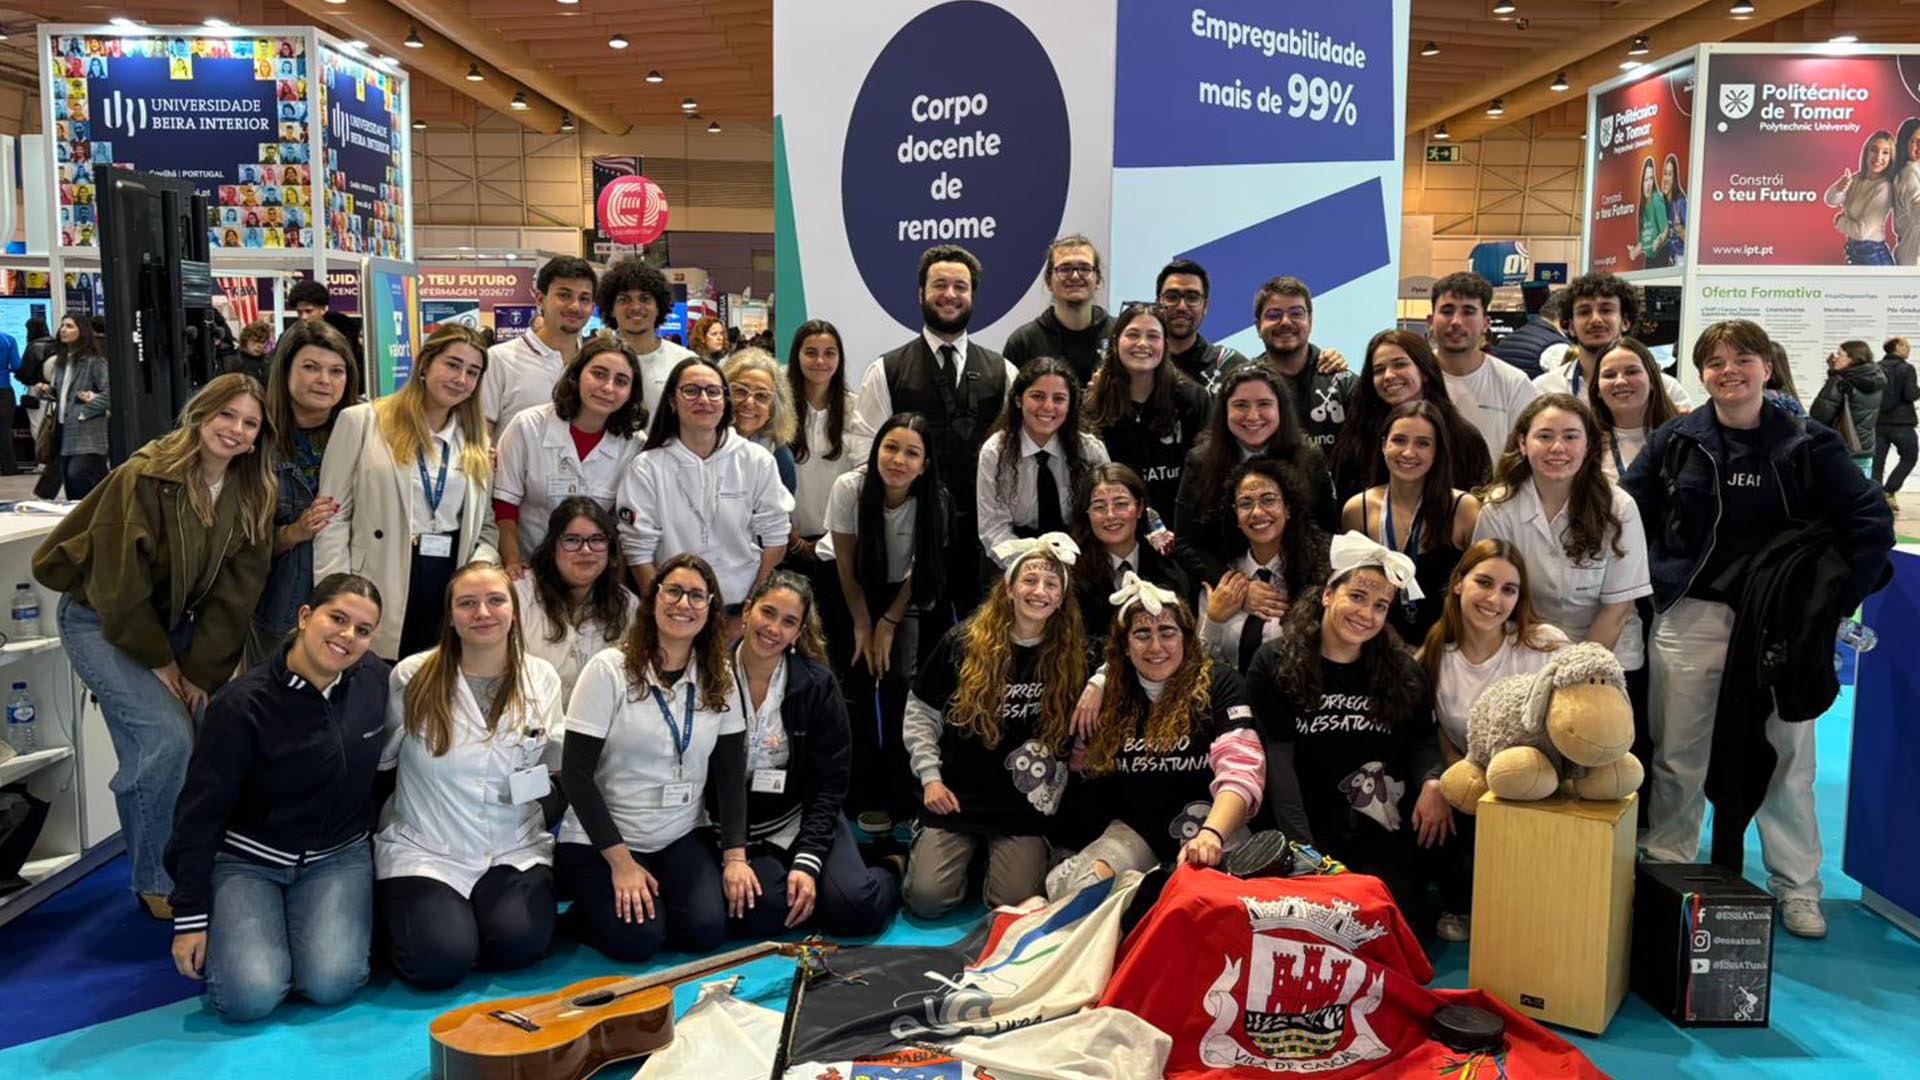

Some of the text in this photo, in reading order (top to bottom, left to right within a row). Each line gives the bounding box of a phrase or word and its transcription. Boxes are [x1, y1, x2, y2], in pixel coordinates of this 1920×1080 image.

[1191, 8, 1366, 69] Empregabilidade
[1199, 72, 1358, 126] mais de 99%
[1762, 83, 1869, 101] Politécnico
[151, 98, 261, 113] UNIVERSIDADE
[911, 93, 988, 125] Corpo
[1760, 102, 1854, 119] de Tomar
[152, 116, 270, 131] BEIRA INTERIOR
[1759, 121, 1861, 133] Polytechnic University
[1614, 123, 1652, 145] de Tomar
[897, 130, 1002, 164] docente
[182, 170, 225, 178] PORTUGAL
[1730, 173, 1784, 186] Constrói
[930, 171, 963, 200] de
[1712, 187, 1817, 201] o teu Futuro
[898, 216, 997, 241] renome
[1712, 244, 1774, 256] www.ipt.pt
[427, 274, 455, 286] TEU
[459, 274, 518, 286] FUTURO
[1702, 286, 1747, 299] Oferta
[1751, 287, 1822, 299] Formativa
[1727, 472, 1761, 487] JEA
[1234, 1048, 1269, 1068] VILA
